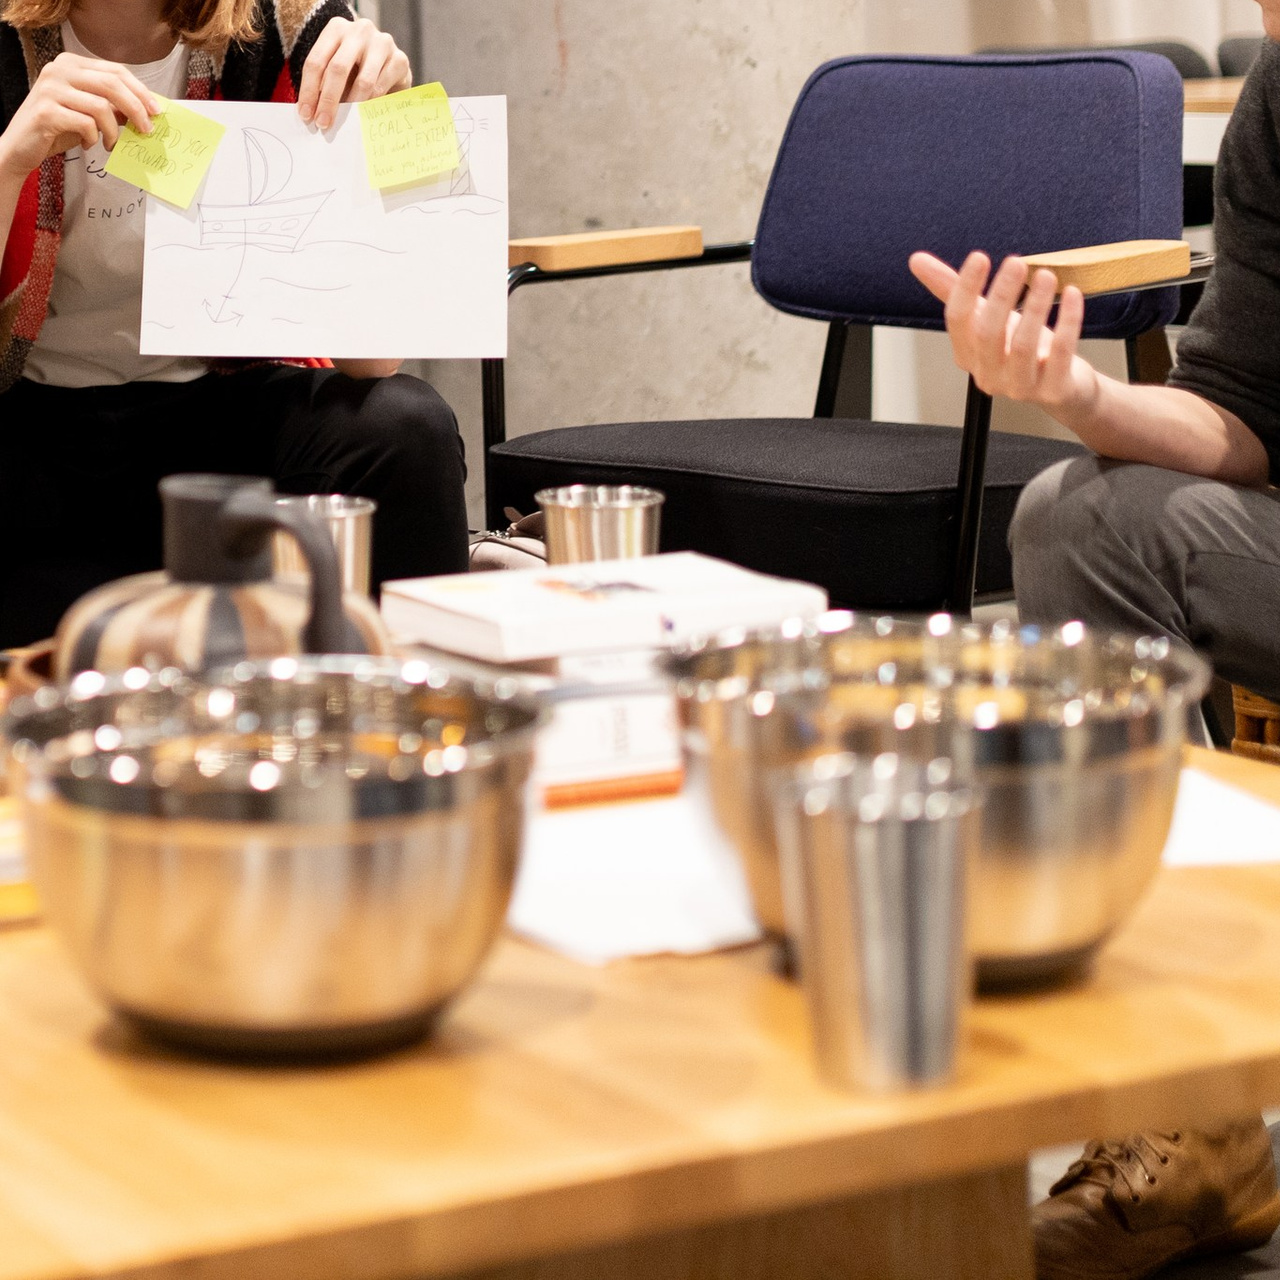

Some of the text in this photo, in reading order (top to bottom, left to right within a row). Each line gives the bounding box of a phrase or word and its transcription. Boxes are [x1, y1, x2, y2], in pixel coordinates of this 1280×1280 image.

[363, 101, 390, 120] What
[369, 107, 439, 142] GOALS and
[87, 197, 144, 219] ENJOY
